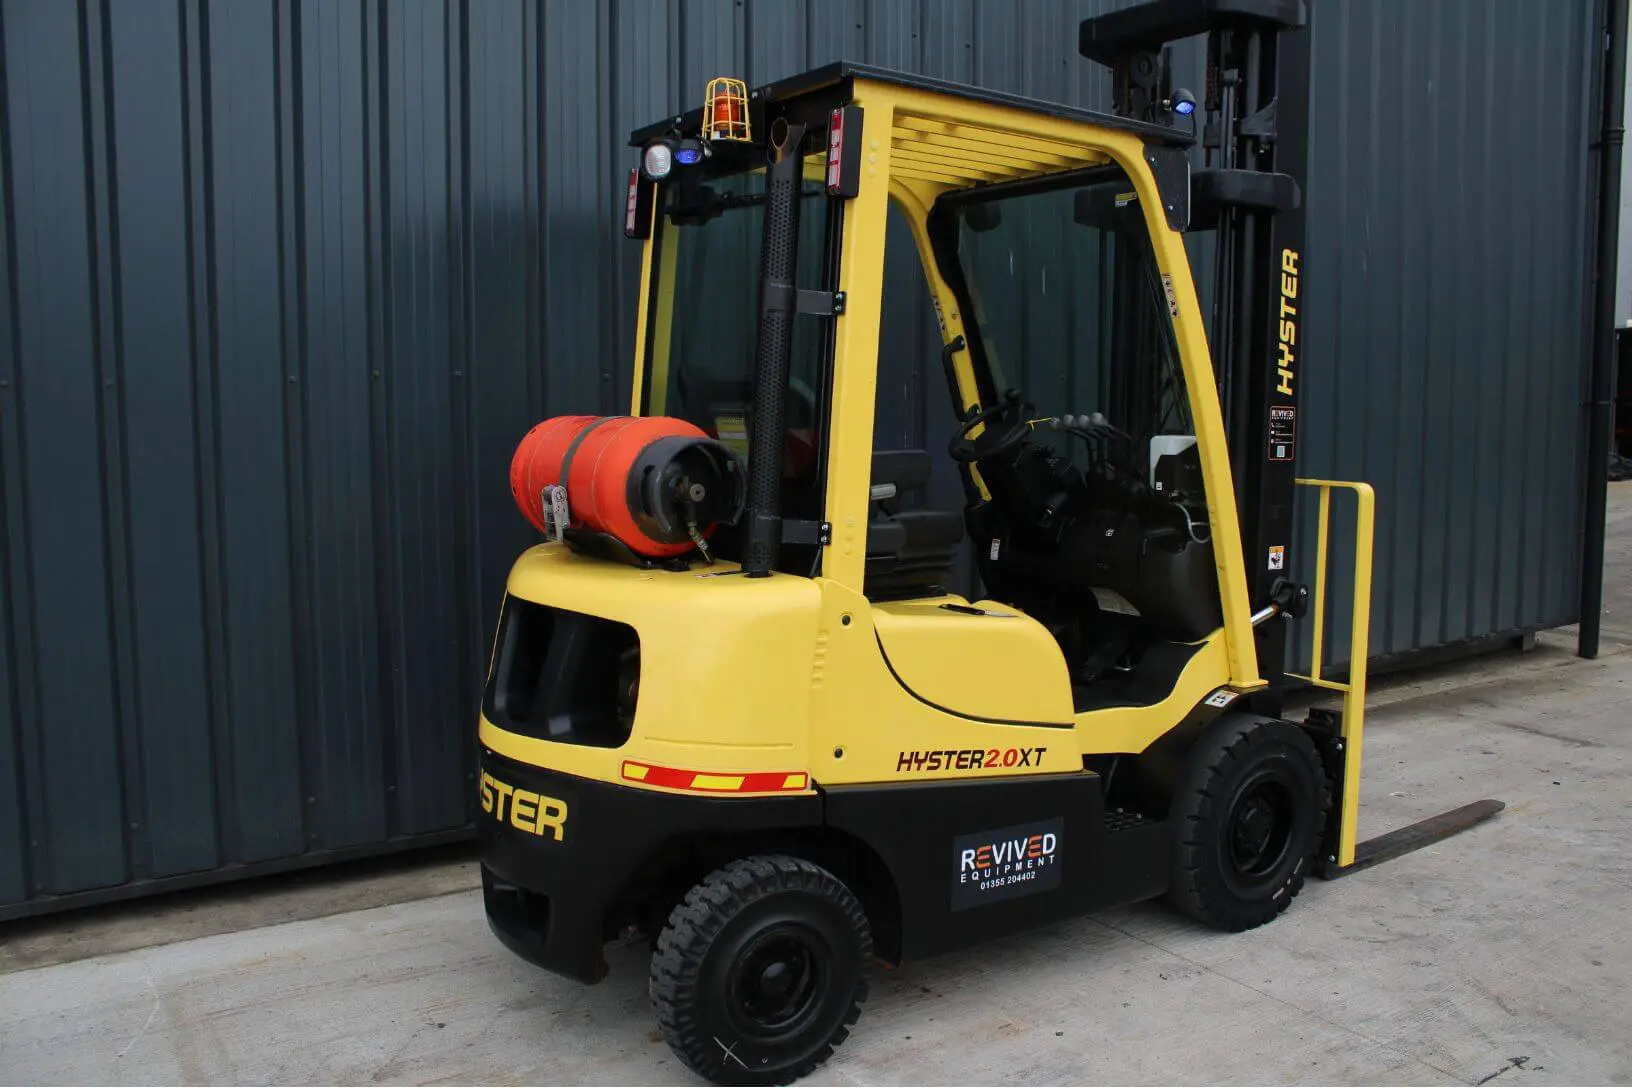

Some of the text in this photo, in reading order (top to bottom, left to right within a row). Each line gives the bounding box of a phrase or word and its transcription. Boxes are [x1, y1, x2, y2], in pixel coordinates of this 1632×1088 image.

[1276, 248, 1299, 396] HYSTER
[480, 767, 568, 842] STER
[960, 833, 1057, 872] REVIVED
[960, 854, 1056, 884] EQUIPMENT
[980, 870, 1036, 890] 01355 204402
